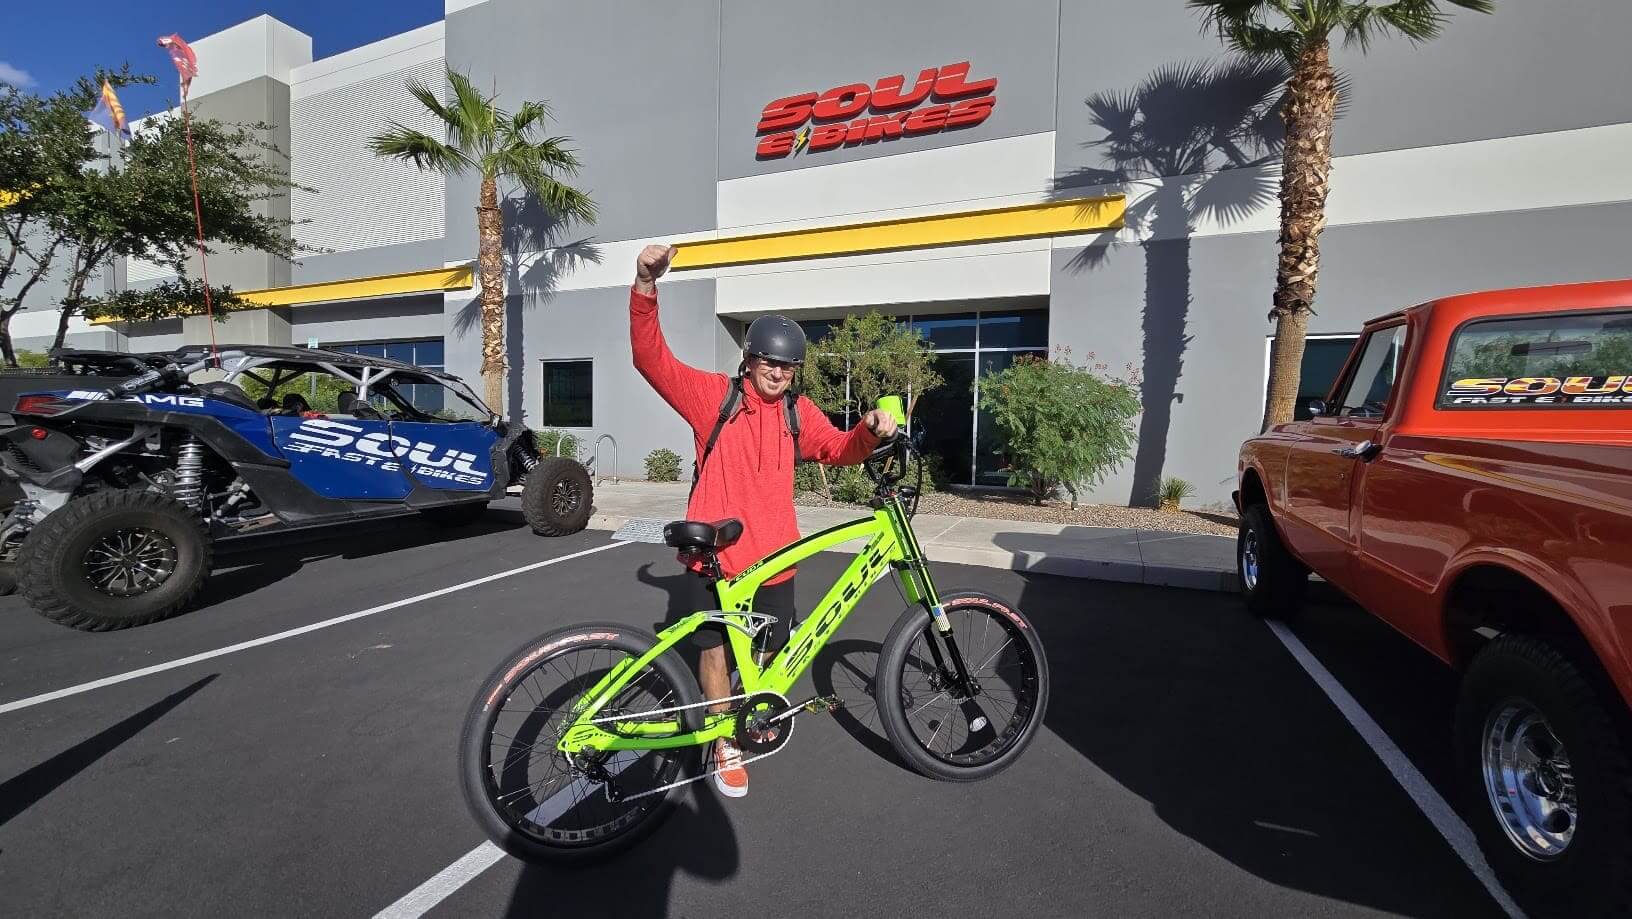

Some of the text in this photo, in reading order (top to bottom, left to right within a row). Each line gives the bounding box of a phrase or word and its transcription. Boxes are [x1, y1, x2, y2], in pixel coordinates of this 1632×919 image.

[756, 61, 997, 136] SOUL
[807, 96, 996, 153] BIKES
[1447, 376, 1632, 395] SOU
[1453, 396, 1524, 404] FAST
[283, 442, 384, 467] FAST
[417, 466, 485, 486] BIKES
[289, 419, 488, 478] SOUL
[785, 540, 896, 678] SOUL
